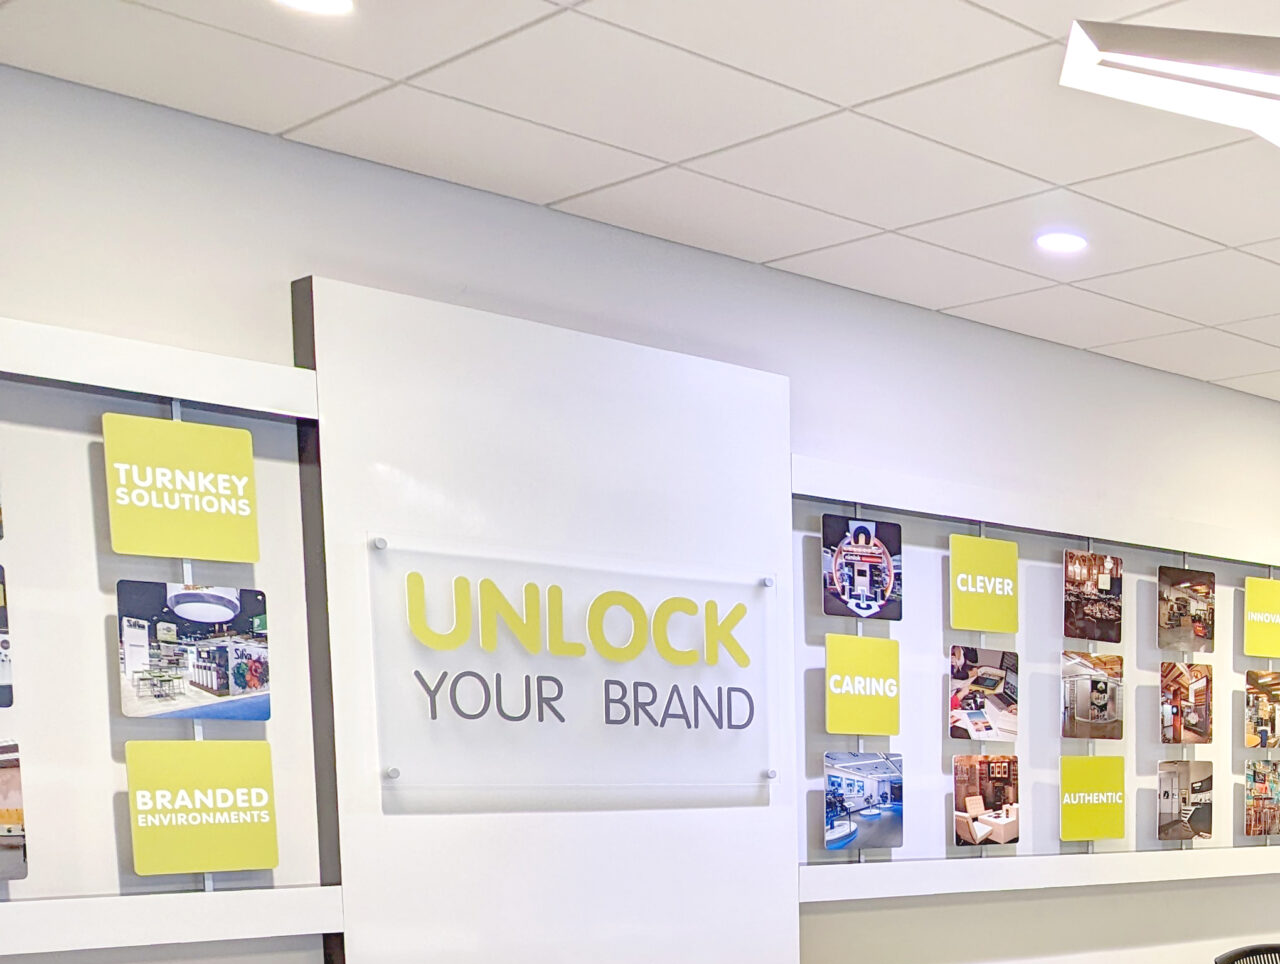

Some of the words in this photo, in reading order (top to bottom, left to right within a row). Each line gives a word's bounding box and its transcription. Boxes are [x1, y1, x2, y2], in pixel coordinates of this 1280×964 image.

[113, 462, 249, 497] TURNKEY
[115, 486, 251, 517] SOLUTIONS
[956, 573, 1014, 597] CLEVER
[405, 571, 751, 669] UNLOCK
[829, 674, 898, 698] CARING
[414, 670, 566, 723] YOUR
[604, 678, 755, 731] BRAND
[135, 787, 269, 811] BRANDED
[1063, 791, 1123, 805] AUTHENTIC
[137, 810, 270, 827] ENVIRONMENTS
